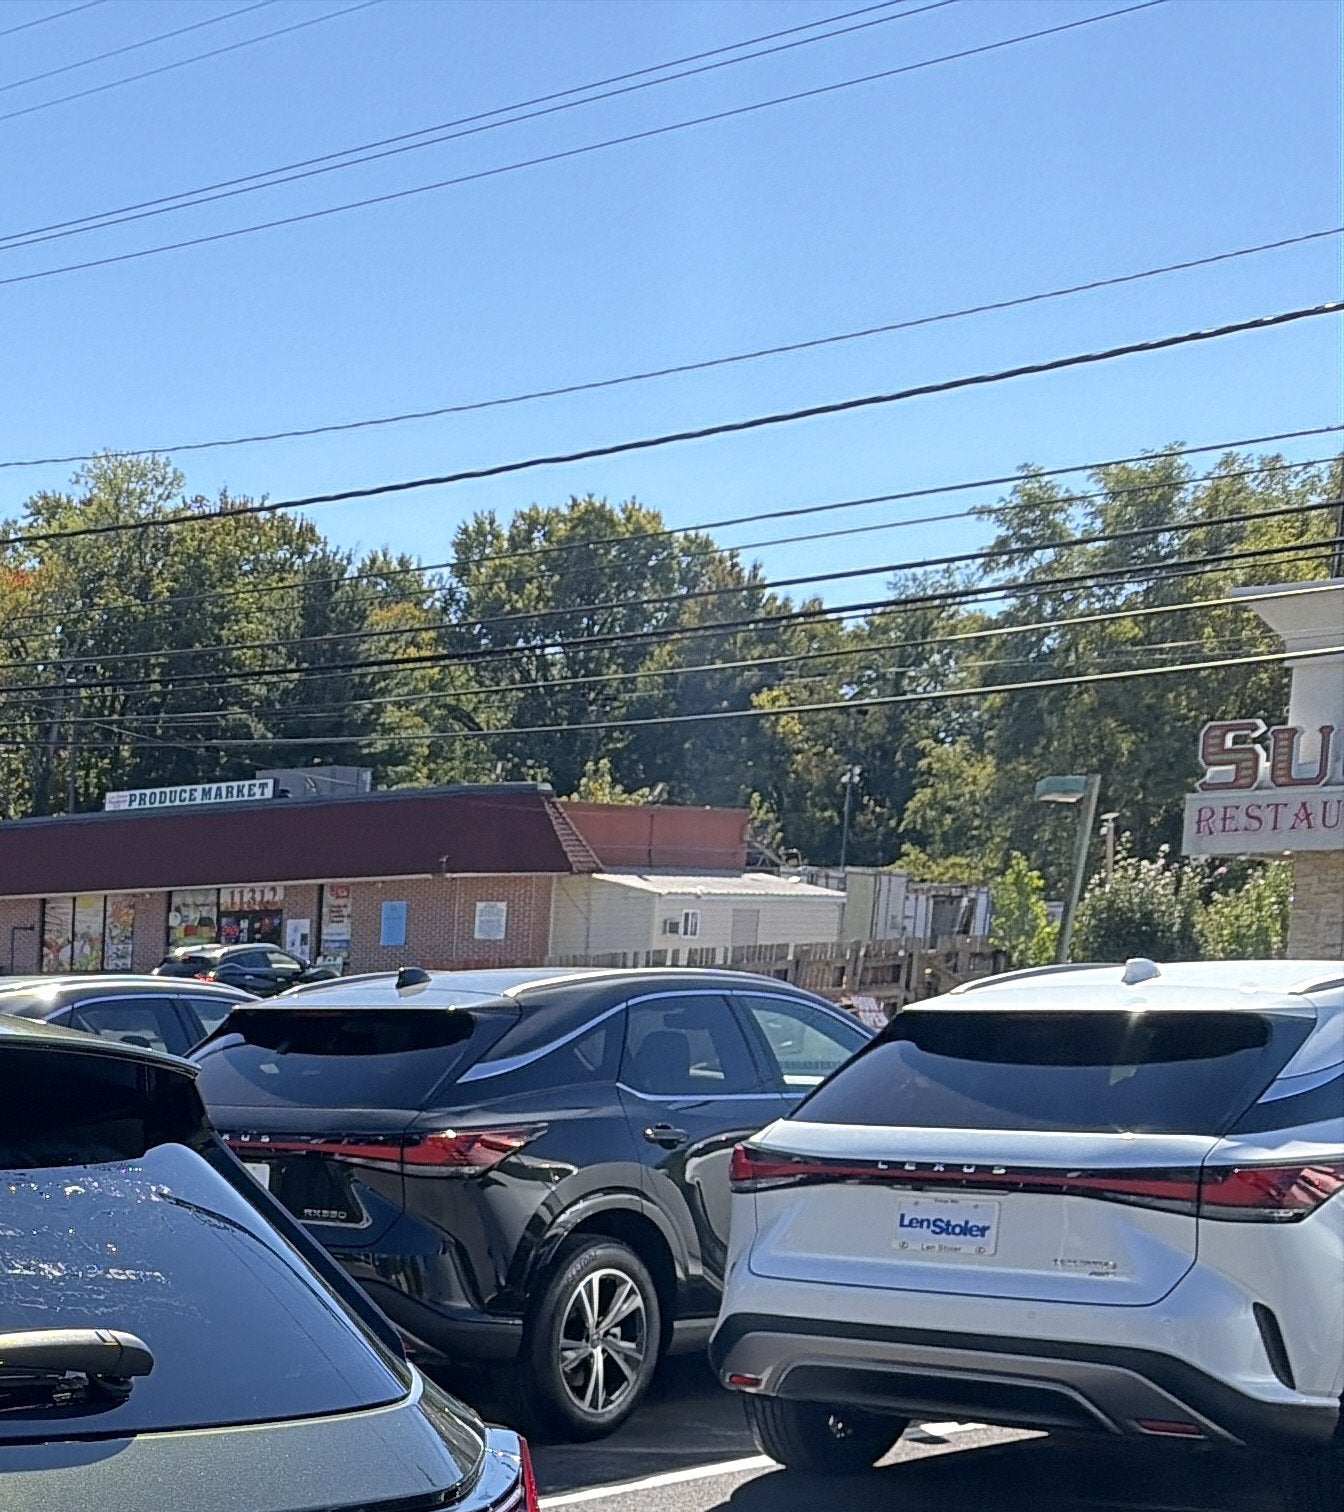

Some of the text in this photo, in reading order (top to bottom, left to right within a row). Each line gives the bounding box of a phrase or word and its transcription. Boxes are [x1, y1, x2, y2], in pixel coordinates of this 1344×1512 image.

[127, 787, 198, 808] PRODUCE
[200, 781, 269, 801] MARKET
[1195, 799, 1343, 836] RESTAU
[229, 886, 280, 908] 11312
[877, 1160, 1007, 1175] LEXUS
